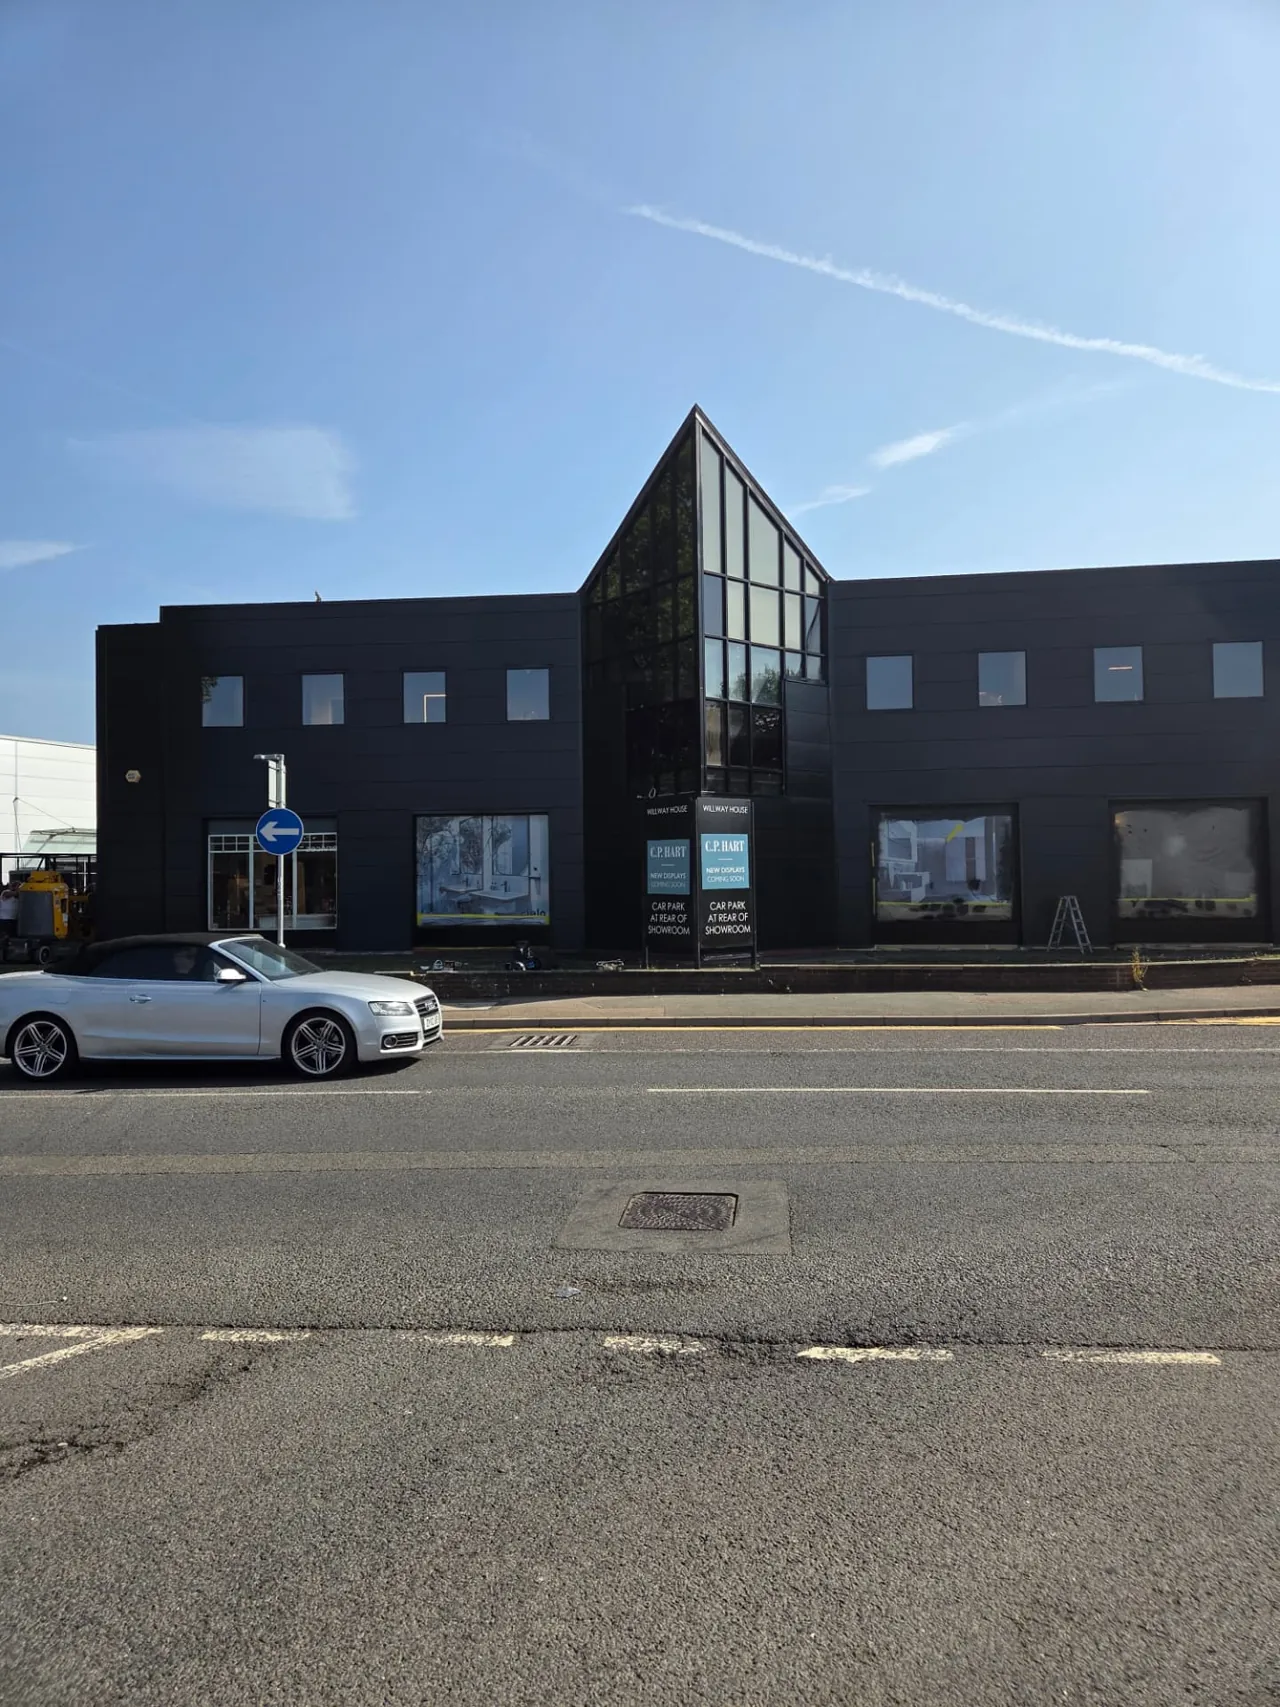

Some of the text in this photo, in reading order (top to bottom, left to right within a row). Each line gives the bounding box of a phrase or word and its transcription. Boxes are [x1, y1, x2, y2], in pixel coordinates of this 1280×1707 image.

[647, 805, 688, 816] WILLWAY HOUSE
[702, 804, 748, 814] WILLWAY HOUSE
[722, 840, 744, 852] HART
[664, 845, 687, 858] HART
[651, 902, 685, 911] CAR PARK
[709, 901, 746, 911] CAR PARK
[650, 913, 688, 923] AT REAR OF
[707, 912, 749, 923] AT REAR OF
[647, 925, 690, 935] SHOWROOM
[705, 924, 751, 935] SHOWROOM
